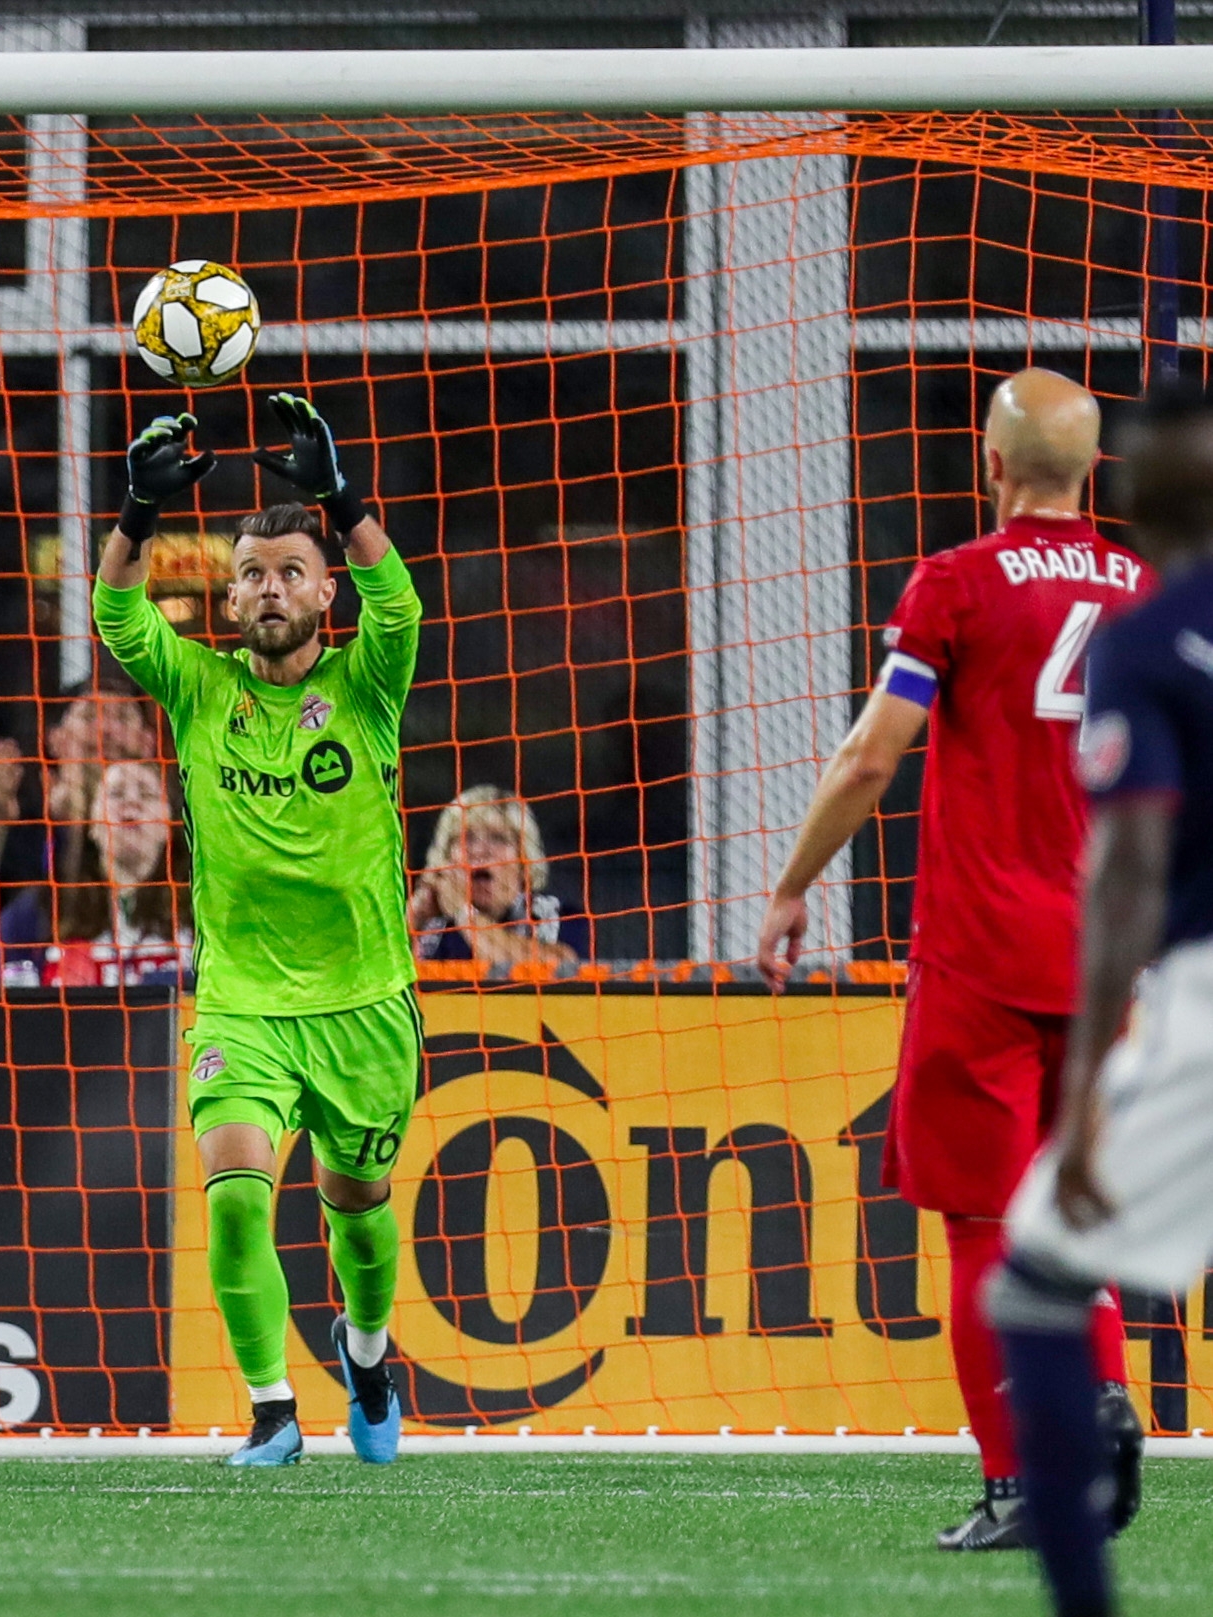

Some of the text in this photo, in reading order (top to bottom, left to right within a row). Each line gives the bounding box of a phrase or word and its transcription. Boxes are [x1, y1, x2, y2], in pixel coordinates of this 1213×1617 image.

[996, 546, 1142, 593] BRADLEY
[1034, 600, 1103, 722] 4
[218, 764, 296, 798] BMO
[355, 1110, 402, 1168] 16
